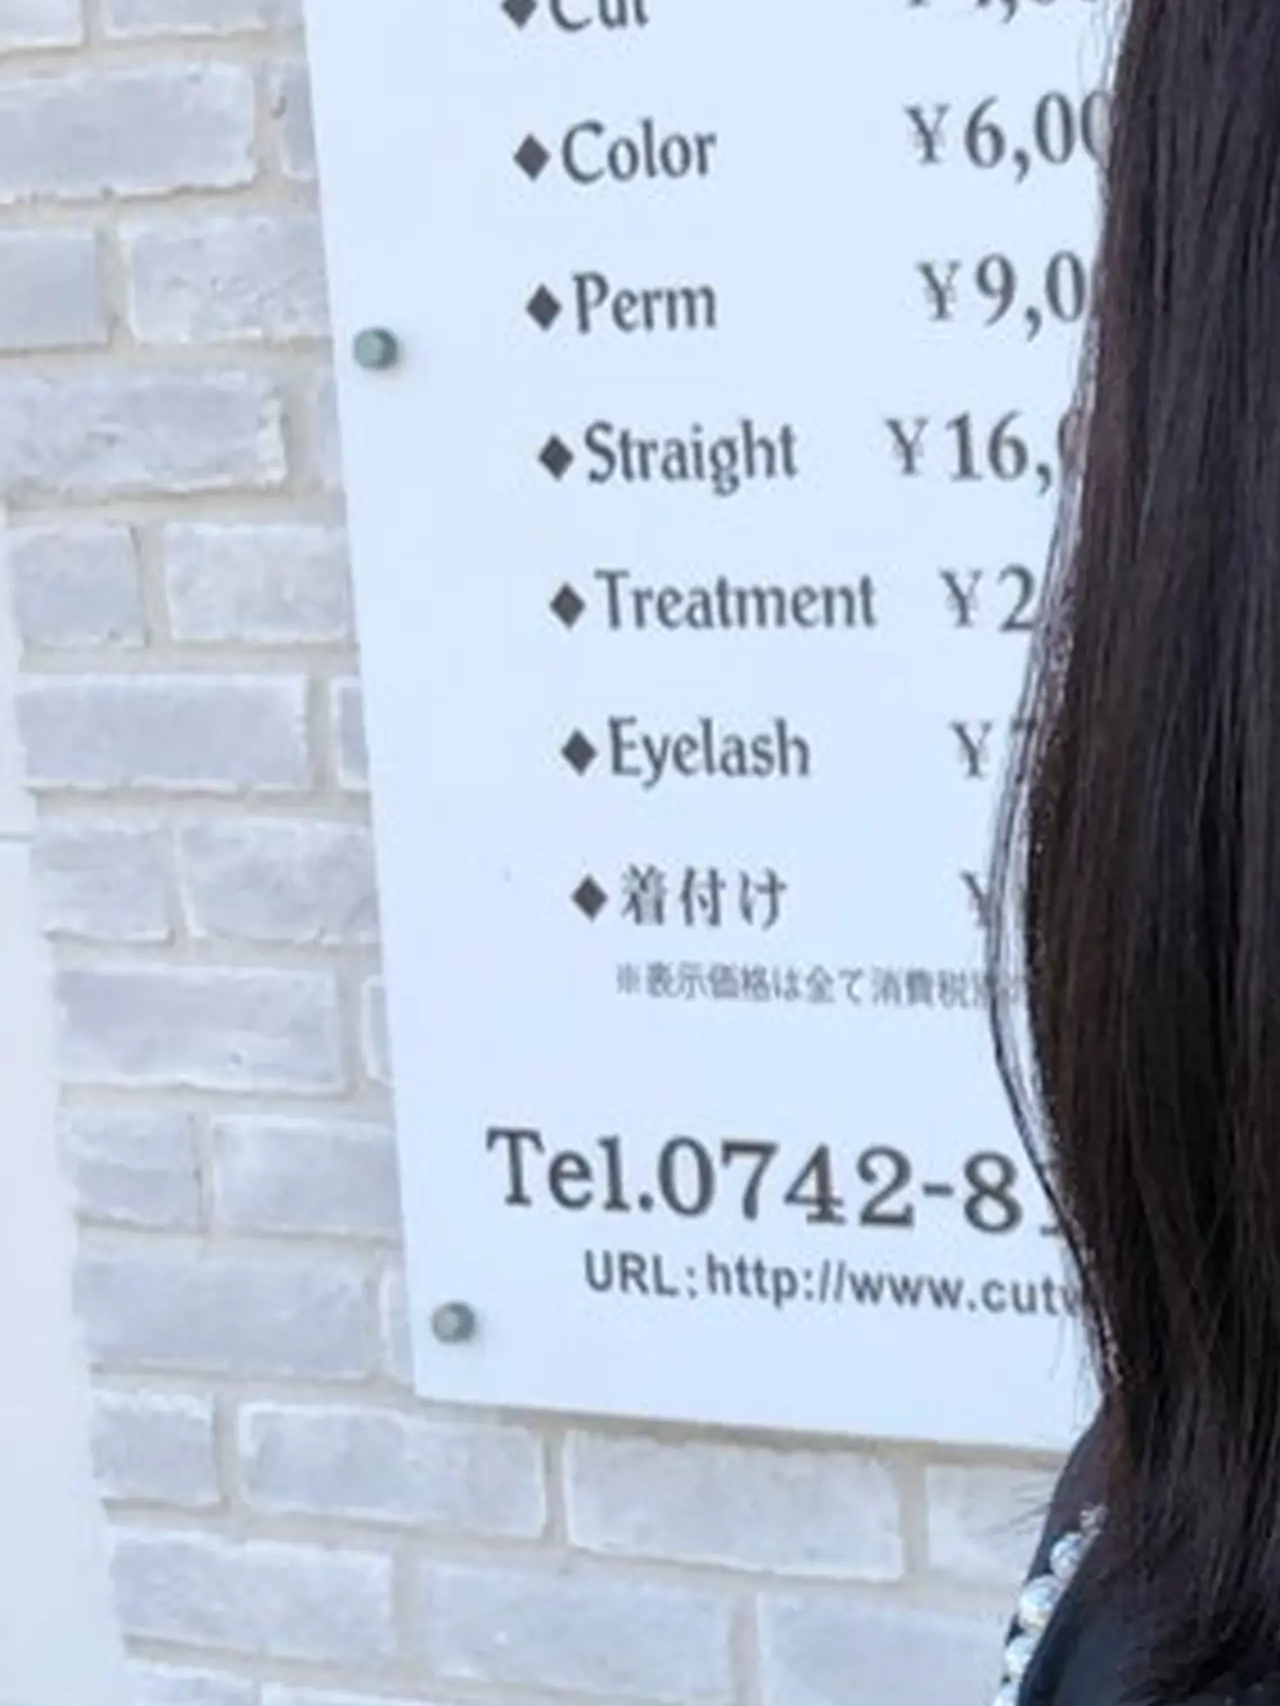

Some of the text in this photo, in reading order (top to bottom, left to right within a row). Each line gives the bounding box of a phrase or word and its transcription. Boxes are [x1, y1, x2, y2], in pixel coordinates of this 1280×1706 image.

[560, 117, 718, 186] Color
[570, 270, 717, 335] Perm
[583, 409, 1068, 498] Straight ¥16,
[593, 568, 877, 631] Treatment
[606, 715, 812, 790] Eyelash
[621, 863, 789, 930] 着付け
[484, 1125, 1060, 1237] Tel.0742-8
